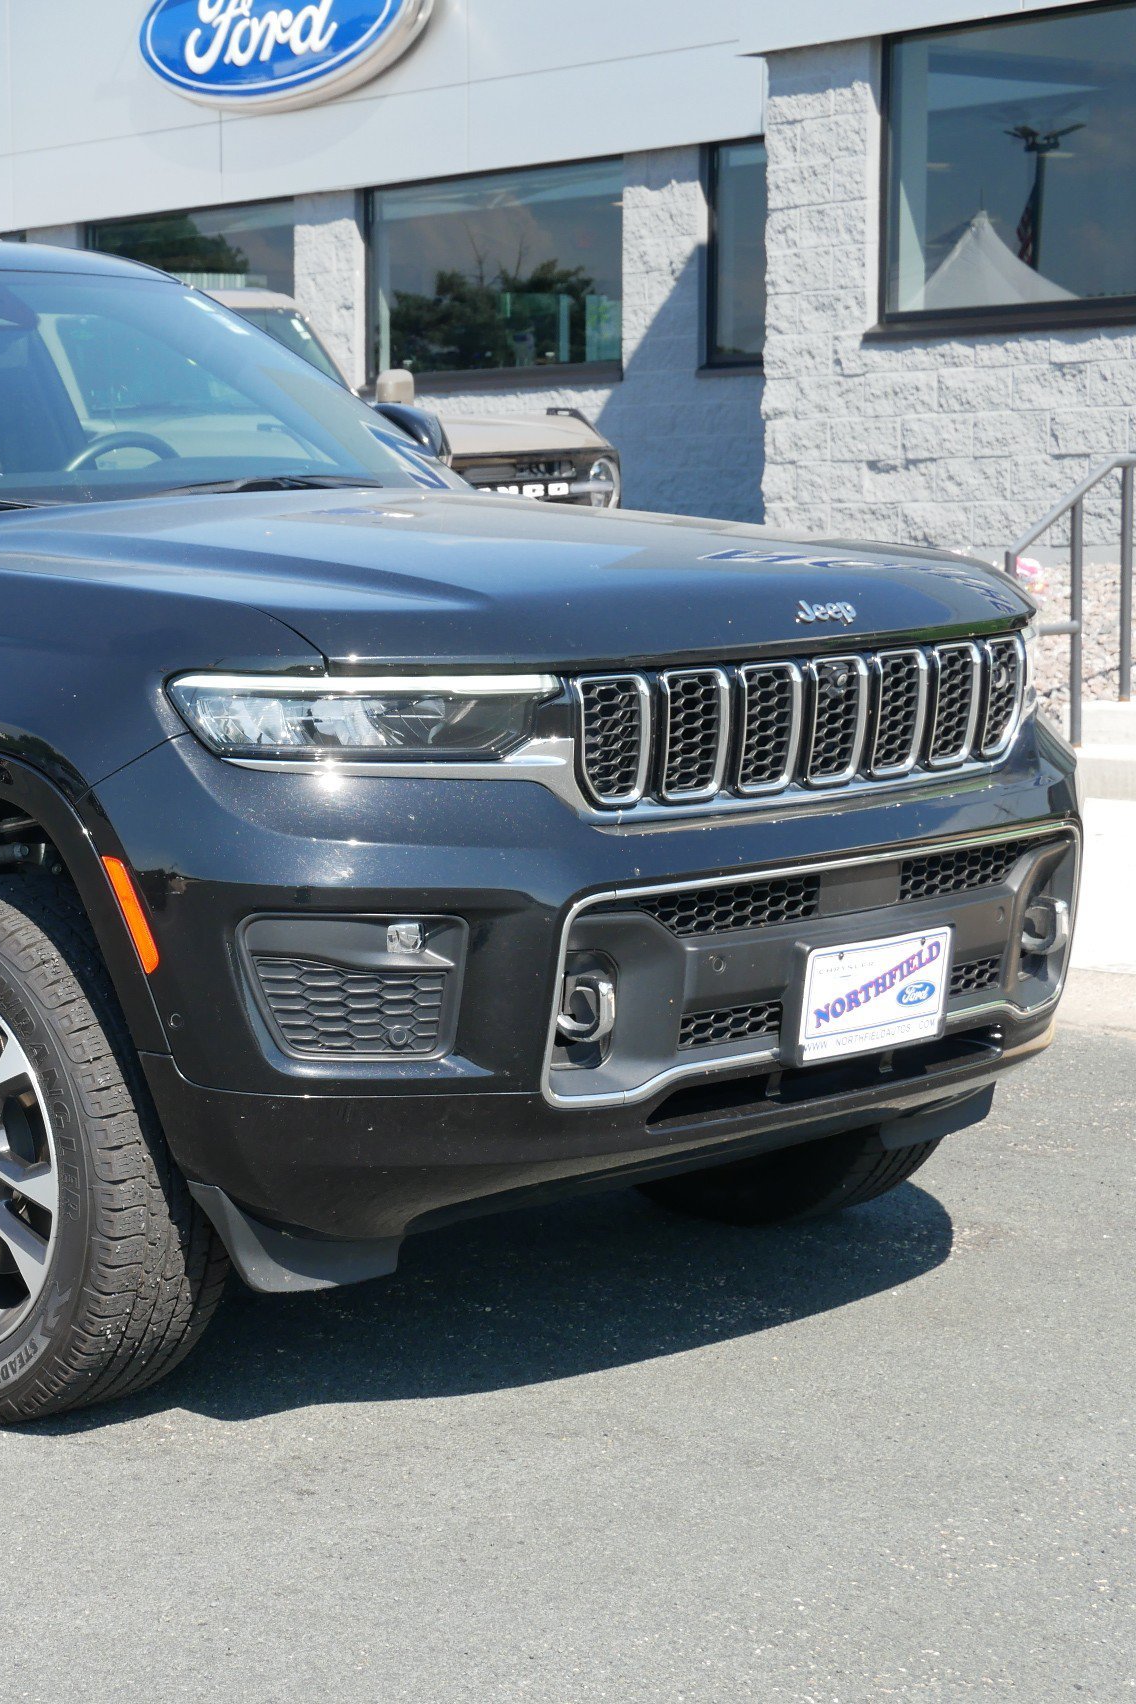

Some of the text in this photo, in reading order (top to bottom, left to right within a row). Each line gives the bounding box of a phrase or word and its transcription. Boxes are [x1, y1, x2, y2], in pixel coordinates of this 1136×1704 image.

[185, 0, 337, 74] Ford
[798, 600, 857, 623] Jeep
[814, 940, 942, 1029] NORTHFIELD
[901, 983, 931, 1005] Ford
